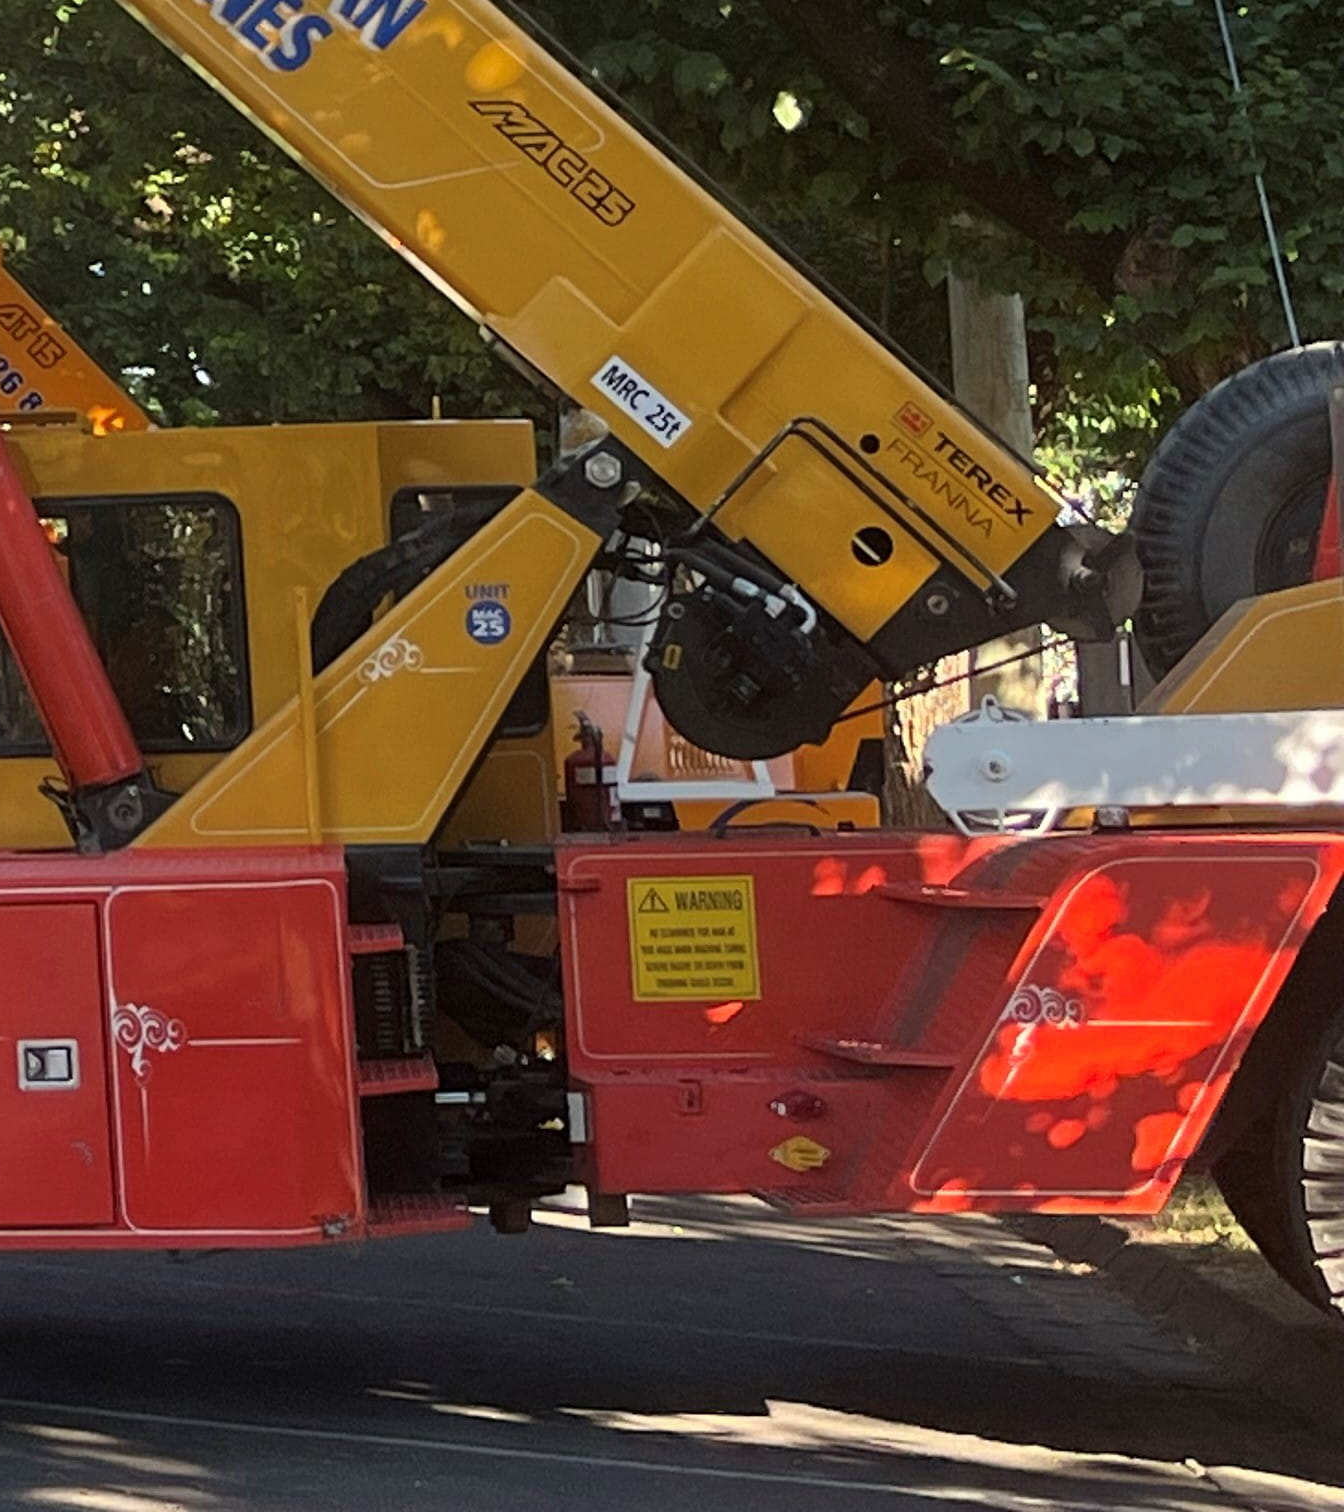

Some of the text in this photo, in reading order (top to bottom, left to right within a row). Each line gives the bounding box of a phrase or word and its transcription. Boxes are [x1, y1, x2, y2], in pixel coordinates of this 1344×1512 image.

[600, 364, 681, 440] MRC 25t
[885, 437, 994, 539] FRANNA
[934, 431, 1035, 526] TEREX
[464, 583, 510, 601] UNIT
[472, 619, 505, 637] 25
[674, 888, 744, 911] WARNING
